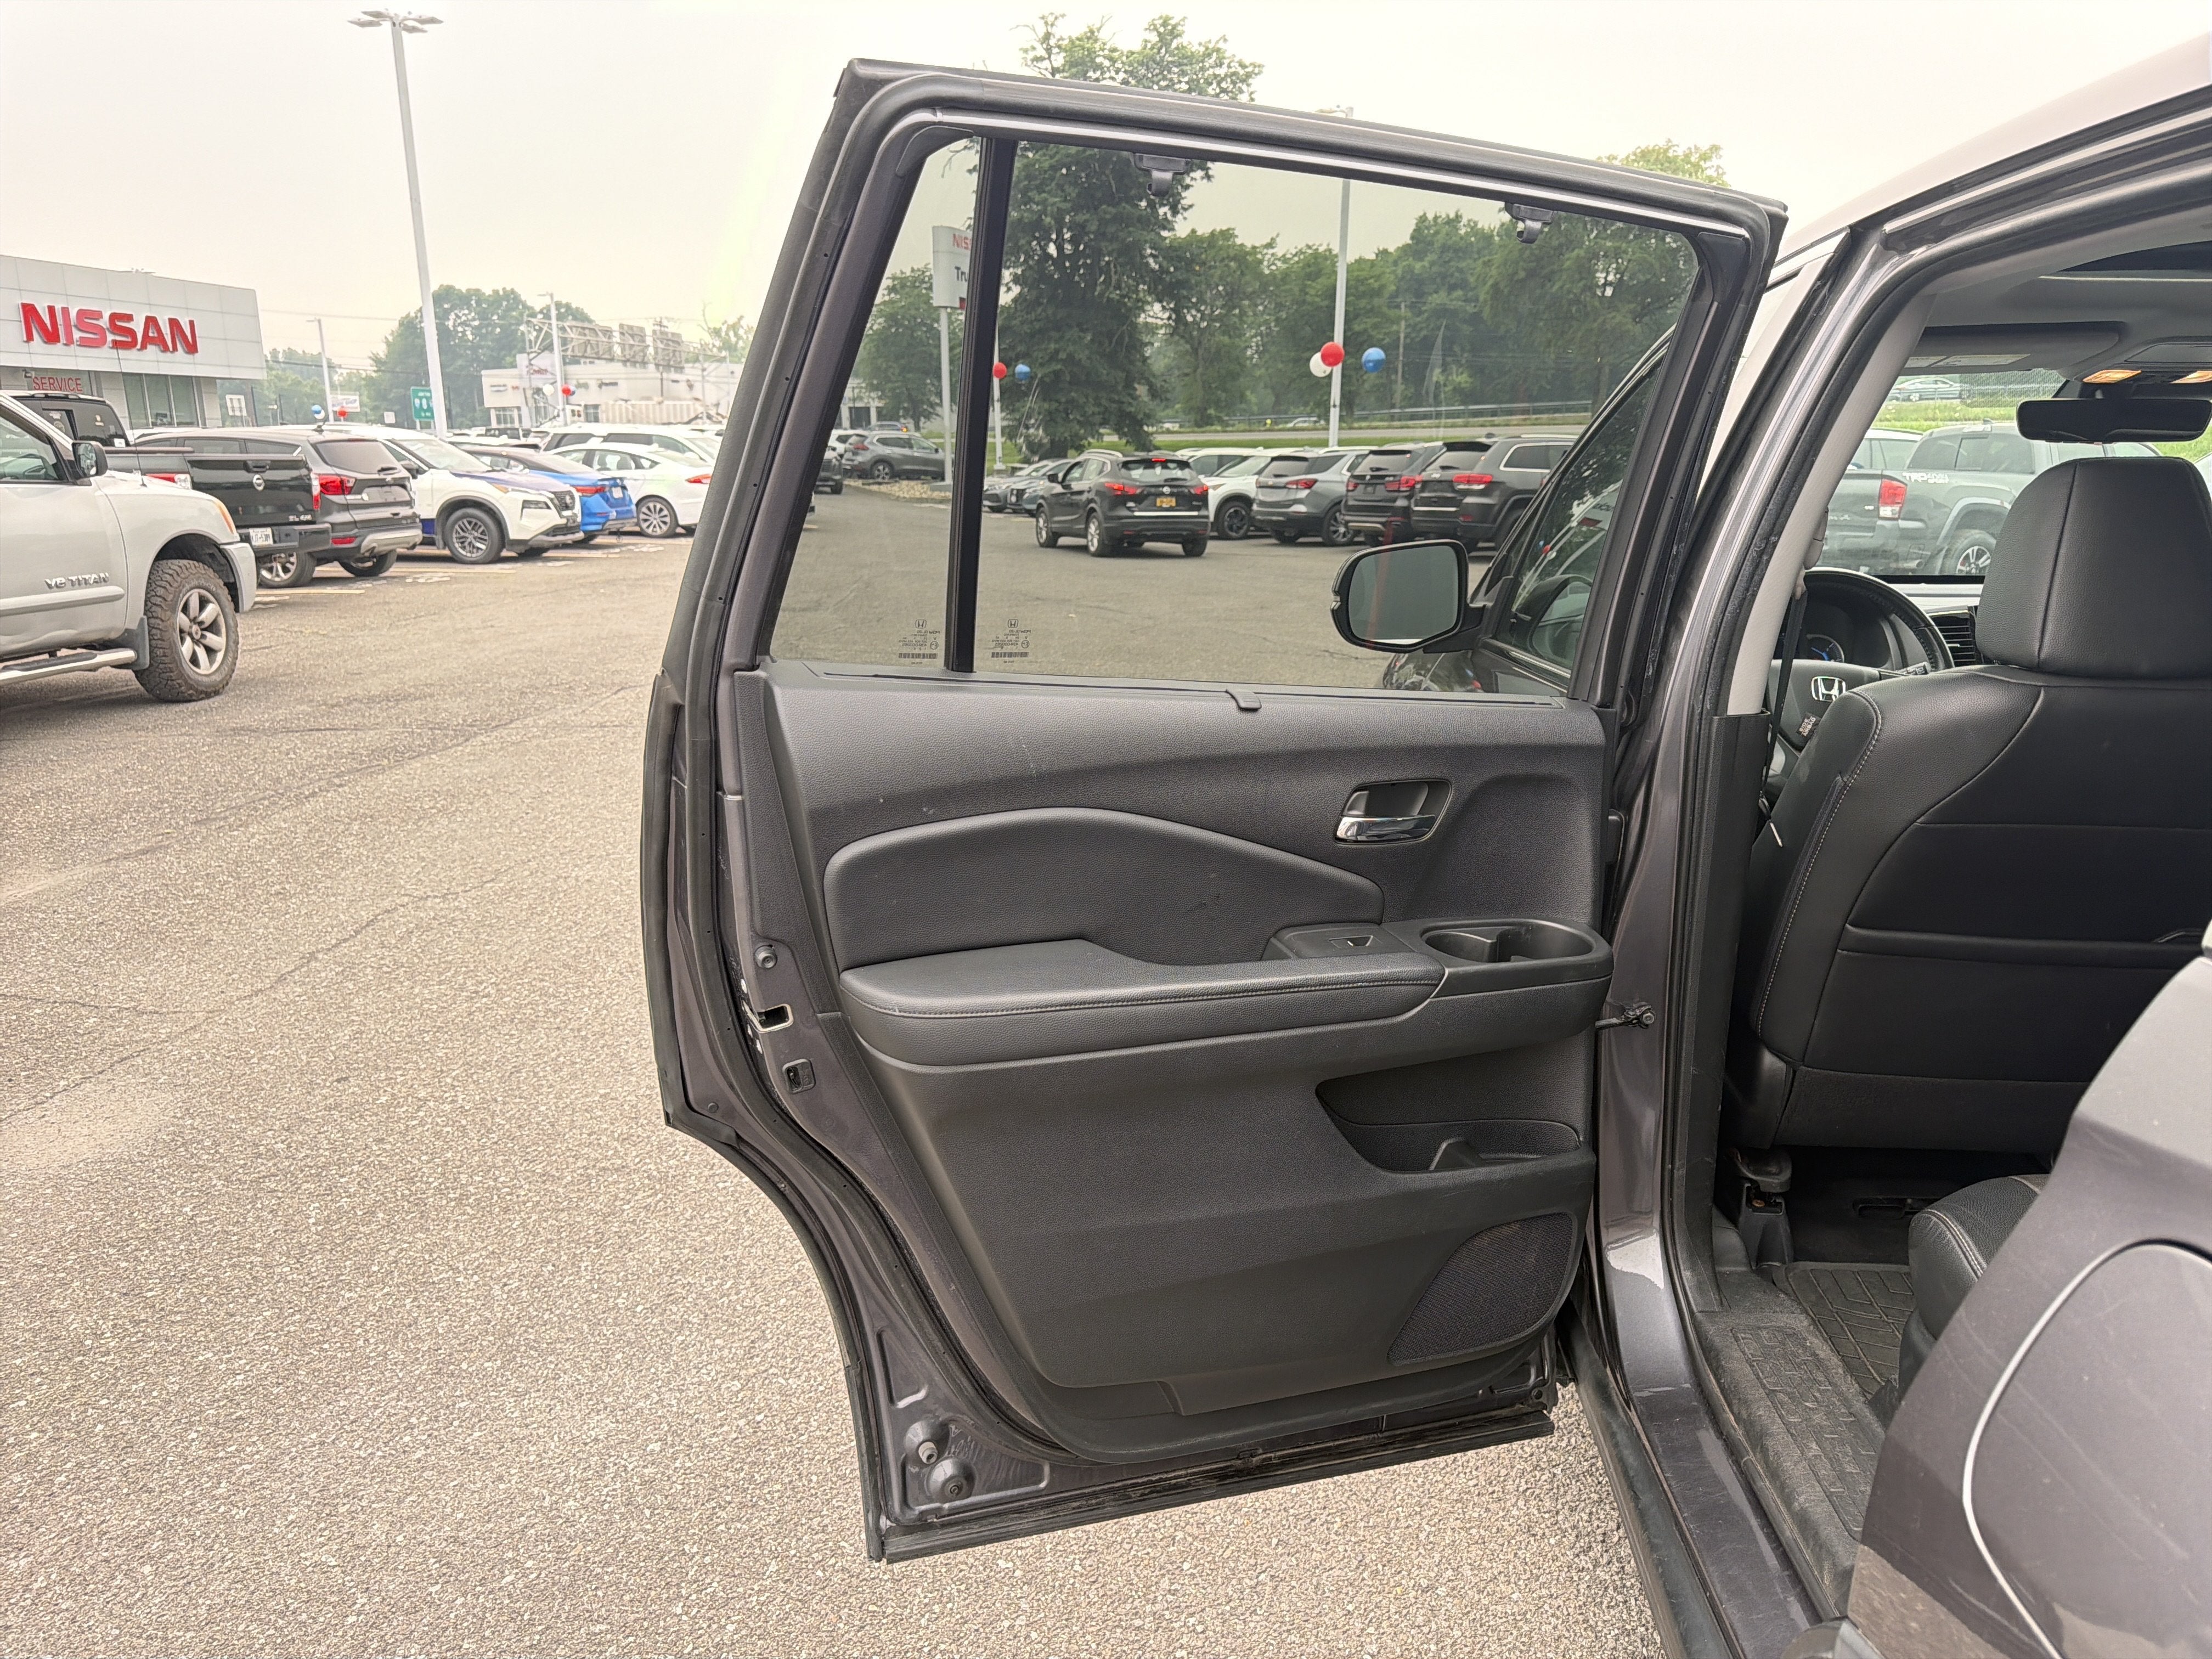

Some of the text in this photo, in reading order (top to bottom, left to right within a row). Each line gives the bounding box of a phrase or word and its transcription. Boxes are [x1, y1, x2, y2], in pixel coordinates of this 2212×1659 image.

[20, 302, 199, 354] NISSAN
[32, 376, 83, 392] SERVICE
[67, 572, 110, 586] TITAN
[1799, 718, 1809, 732] SIDE
